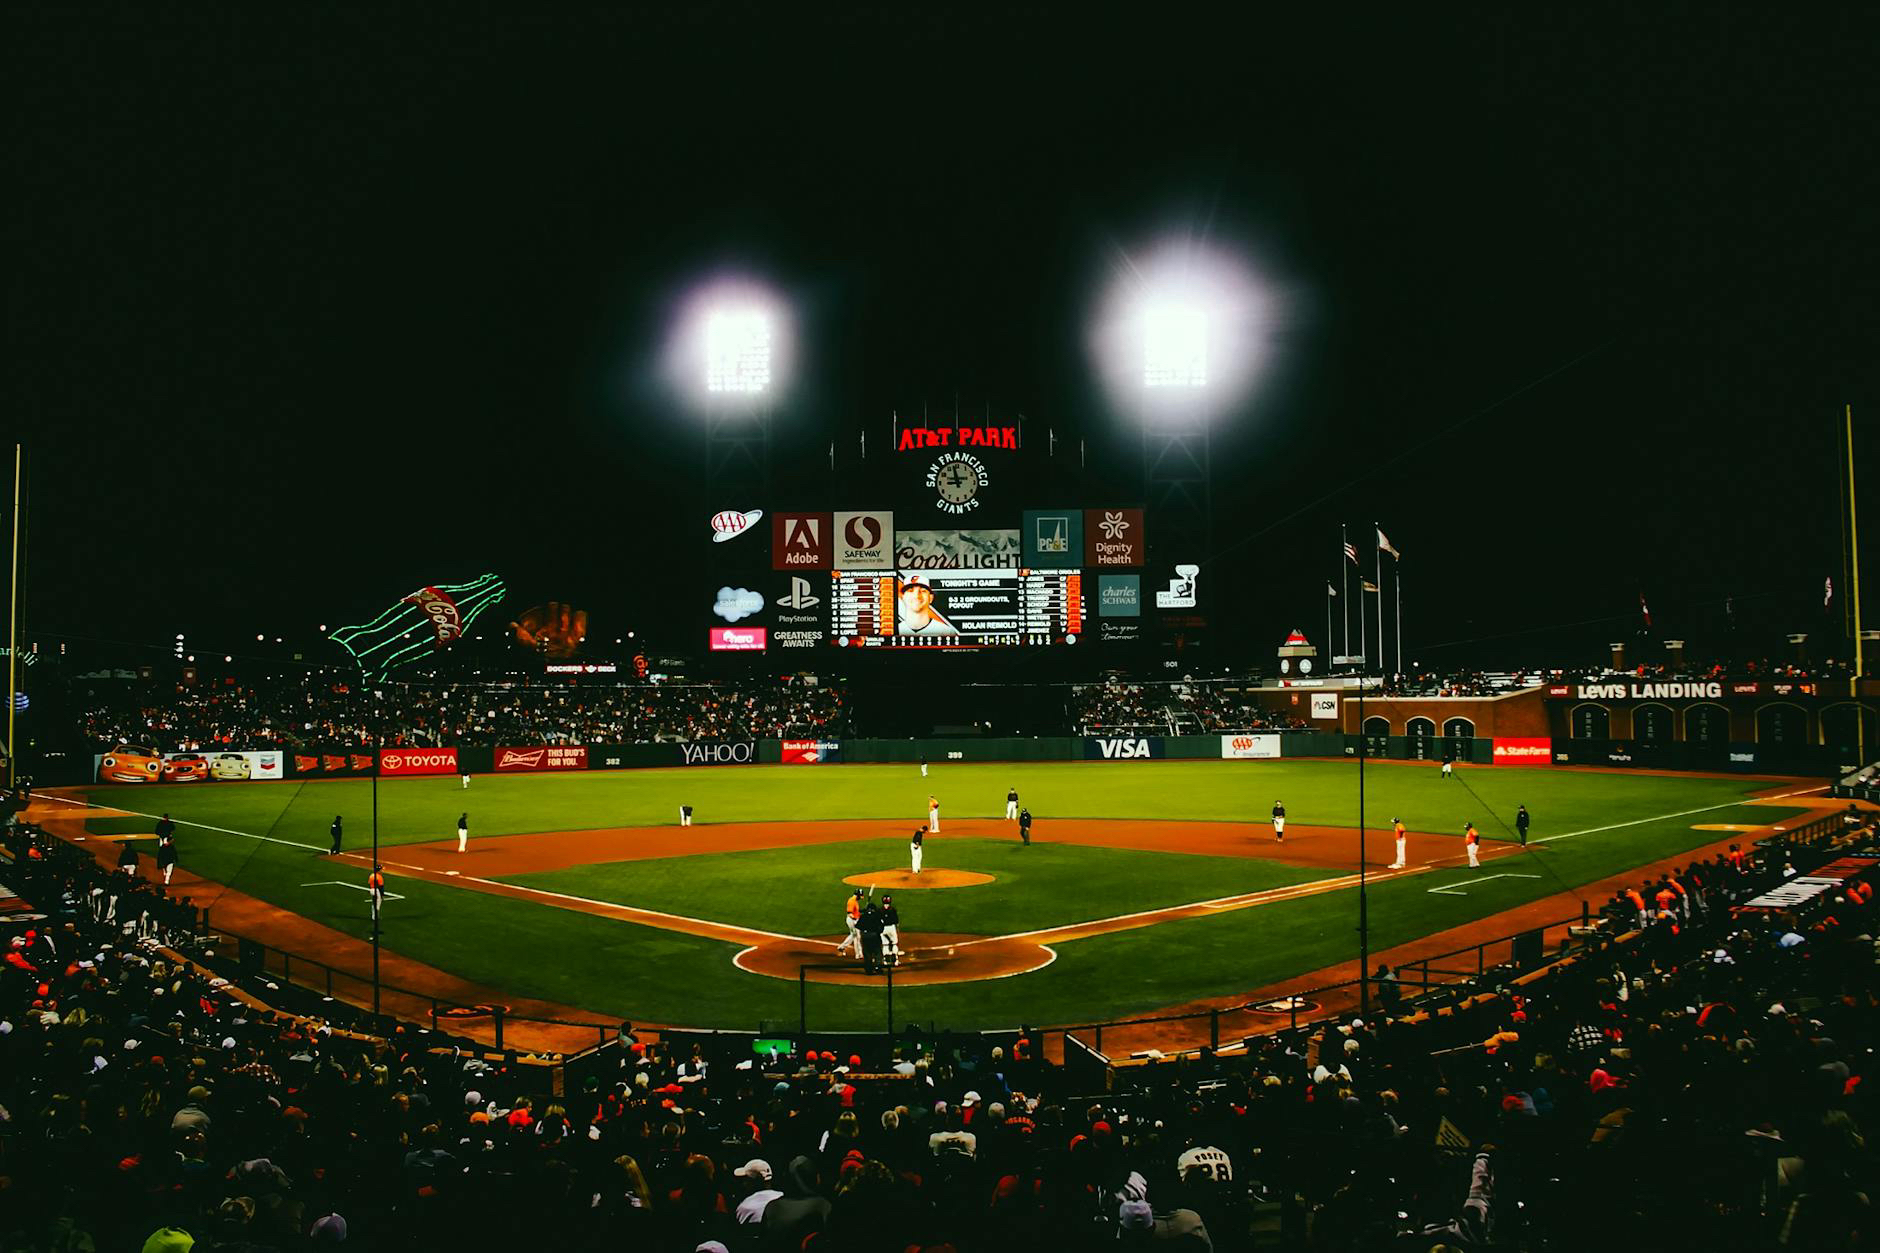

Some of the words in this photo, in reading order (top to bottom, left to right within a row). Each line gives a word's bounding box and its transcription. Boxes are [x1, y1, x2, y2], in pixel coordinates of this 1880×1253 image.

[898, 428, 953, 452] AT&T
[958, 427, 1017, 449] PARK
[926, 464, 940, 488] SAN
[938, 452, 989, 487] FRANCISCO
[936, 498, 980, 514] GIANTS
[1096, 542, 1132, 554] Dignity
[786, 552, 819, 564] Adobe
[897, 546, 960, 569] Coors
[964, 554, 1020, 568] LIGHT
[1098, 555, 1132, 564] Health
[1102, 587, 1136, 596] charles
[778, 615, 818, 624] PlayStation
[774, 632, 822, 640] GREATNESS
[782, 640, 815, 648] AWAITS
[1631, 682, 1722, 698] LANDING
[680, 742, 755, 764] YAHOO!
[1096, 739, 1150, 758] VISA
[404, 755, 457, 767] TOYOTA
[548, 758, 561, 766] FOR
[562, 758, 578, 766] YOU.
[1195, 1153, 1224, 1162] POSEY
